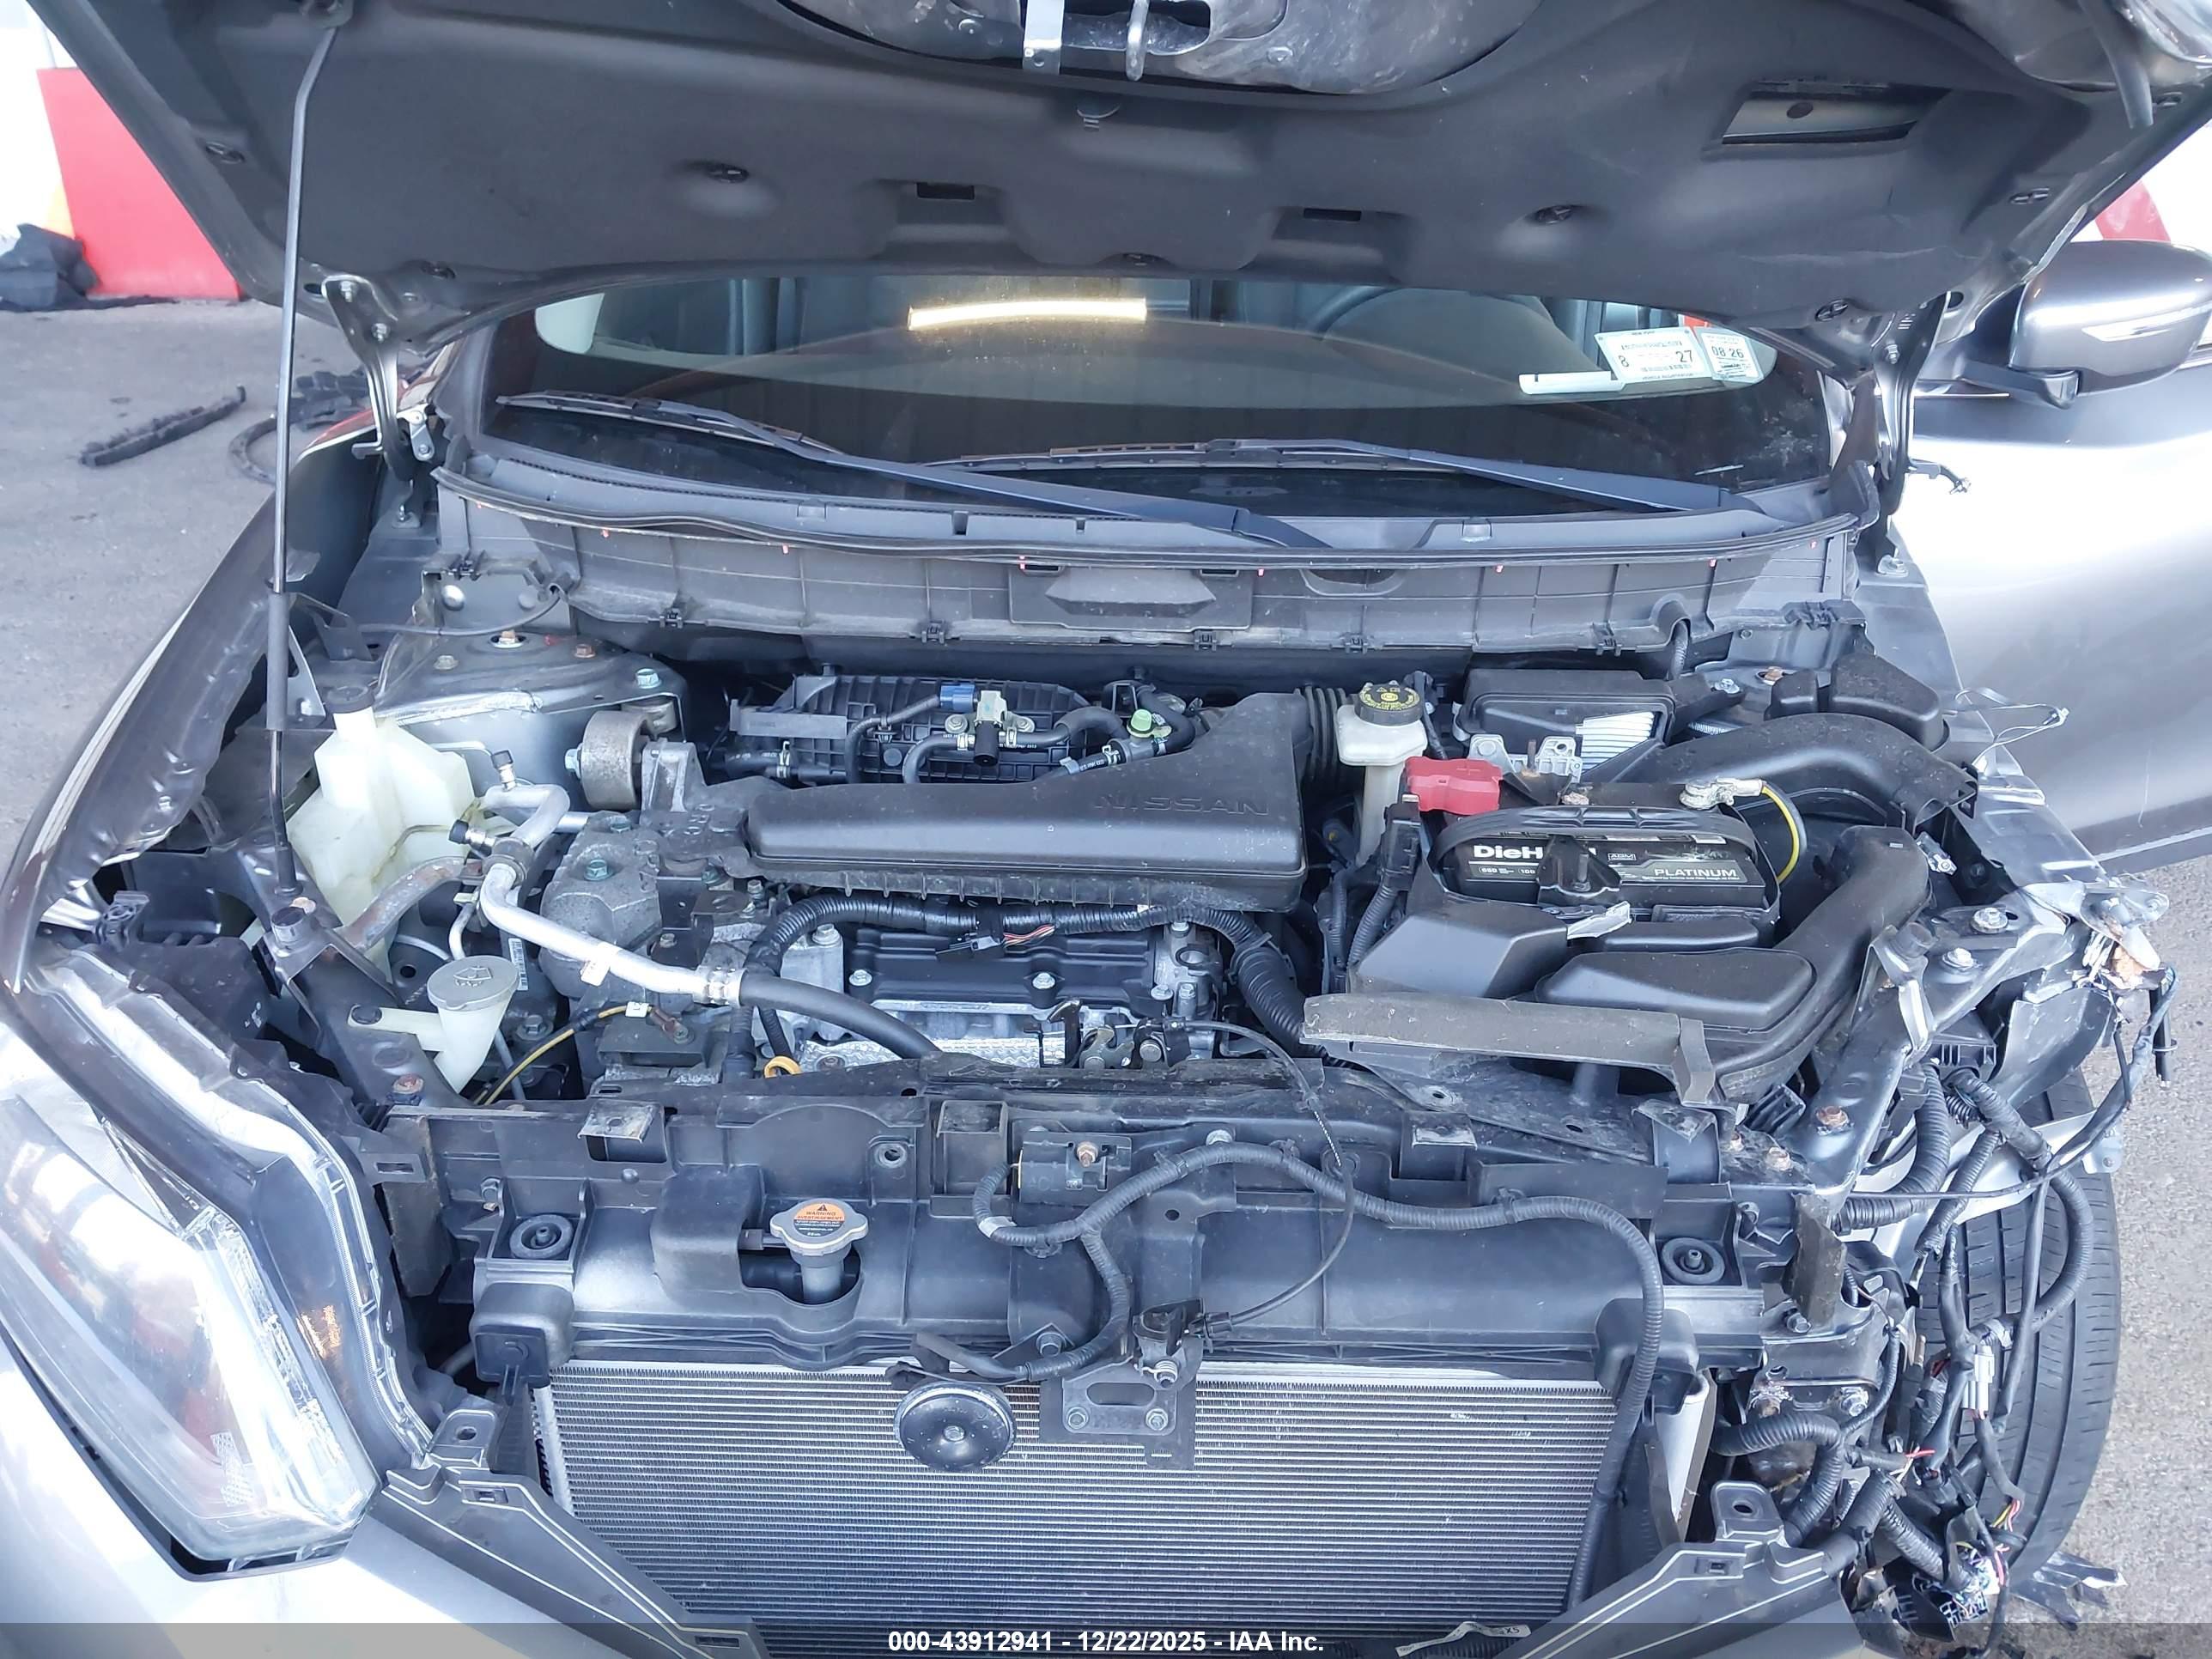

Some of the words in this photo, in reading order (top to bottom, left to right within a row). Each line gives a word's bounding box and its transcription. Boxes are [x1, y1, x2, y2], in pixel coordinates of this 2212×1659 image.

[1675, 349, 1693, 363] 27
[1094, 793, 1269, 816] NISSAN
[1654, 867, 1737, 878] PLATINUM
